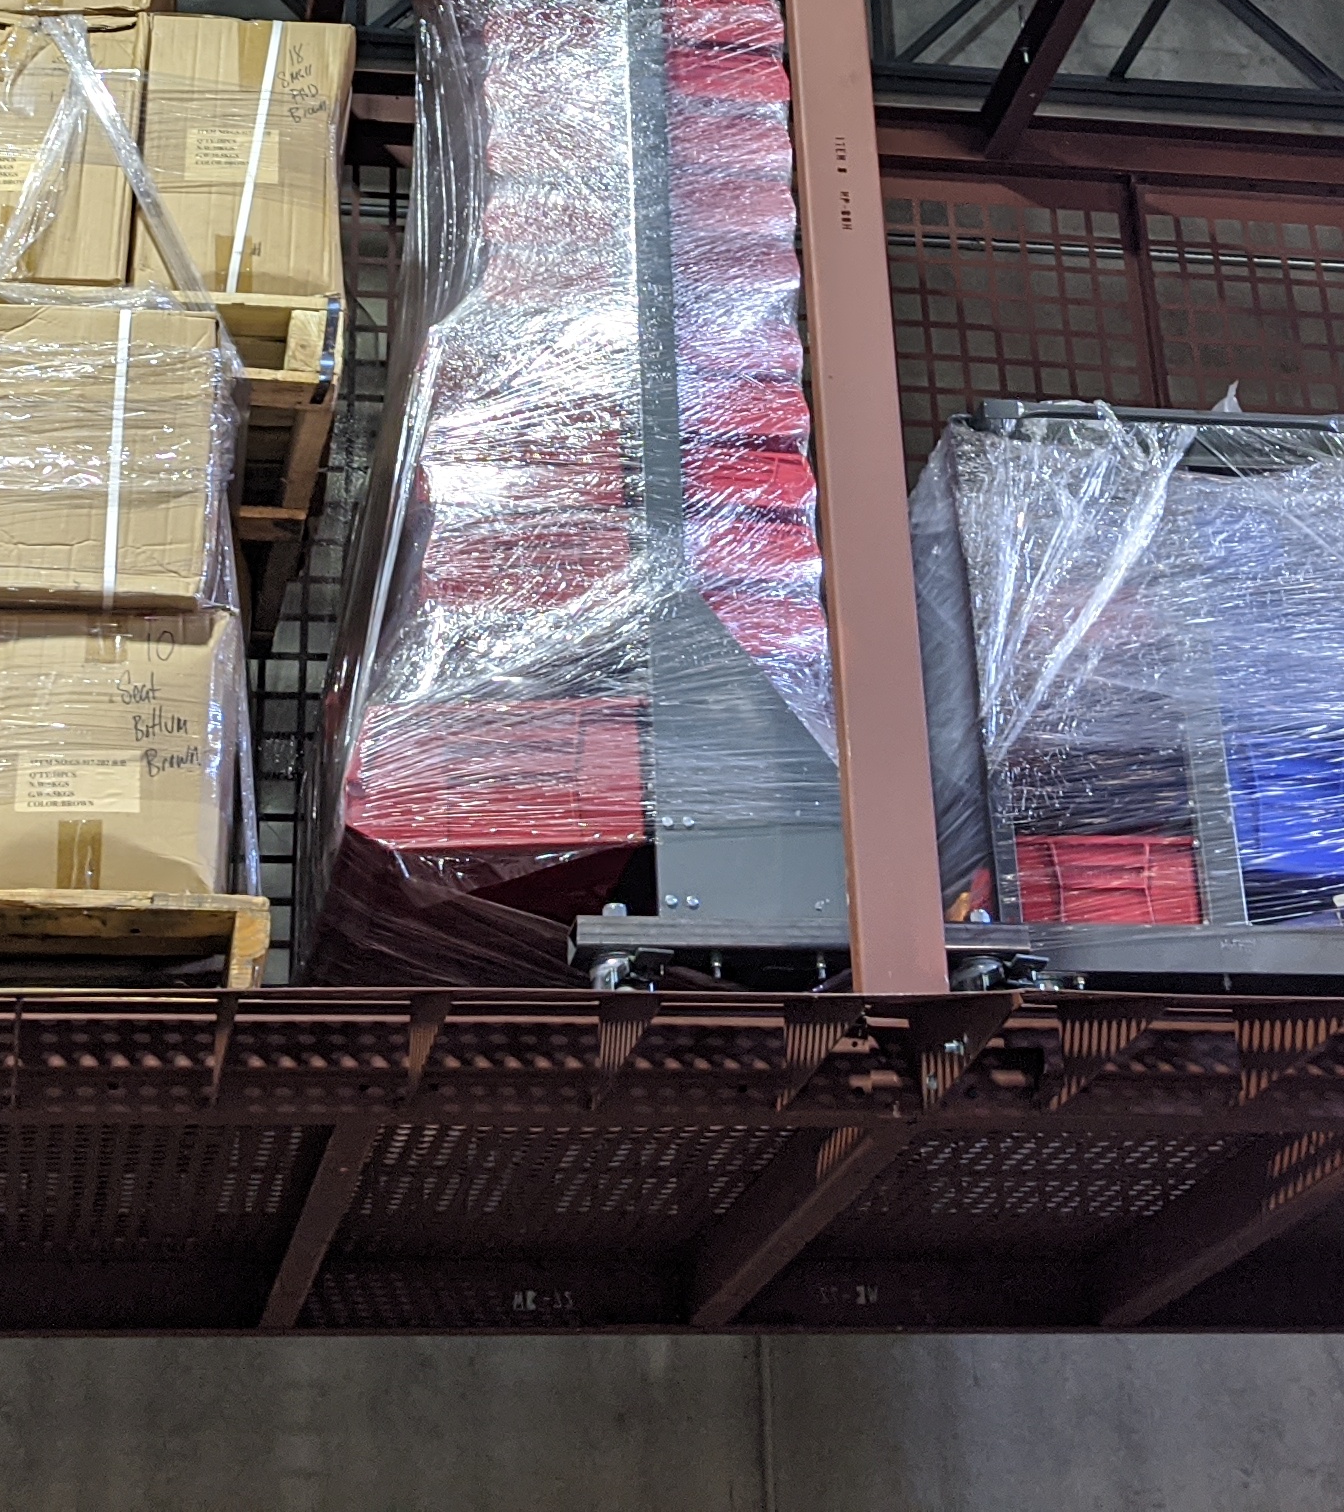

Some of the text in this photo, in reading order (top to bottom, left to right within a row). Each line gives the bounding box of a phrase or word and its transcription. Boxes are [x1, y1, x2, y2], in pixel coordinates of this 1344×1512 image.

[289, 43, 303, 66] 18
[147, 630, 175, 662] 10
[117, 670, 161, 705] Seat
